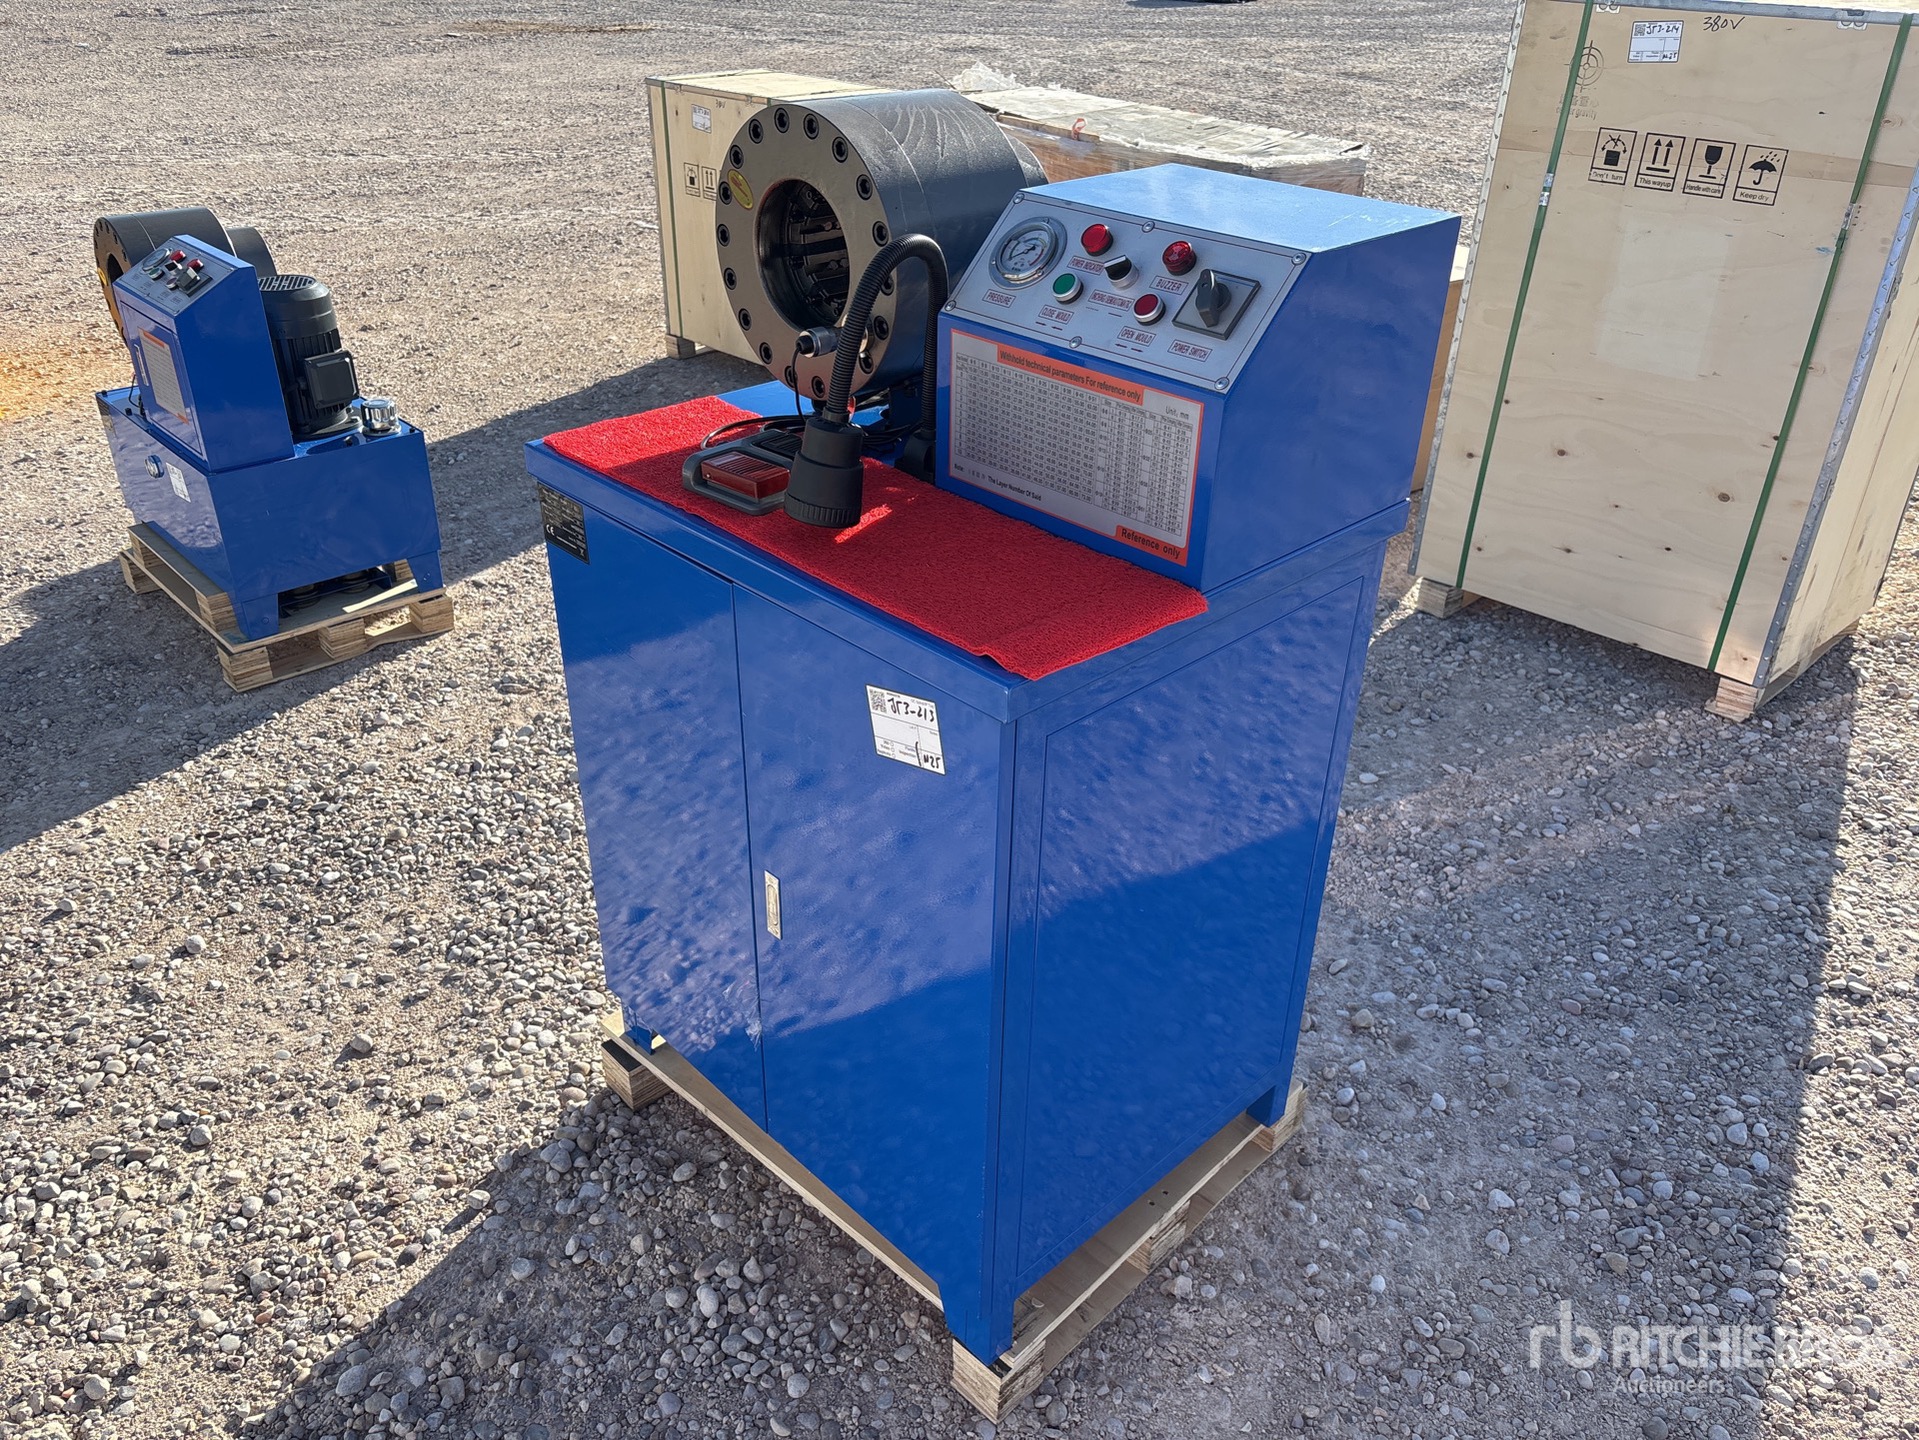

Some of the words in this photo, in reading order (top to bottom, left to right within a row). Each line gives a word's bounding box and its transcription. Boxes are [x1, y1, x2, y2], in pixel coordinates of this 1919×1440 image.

[1703, 16, 1746, 32] 380V
[1740, 191, 1757, 200] Keep
[1758, 194, 1769, 202] dry
[1155, 279, 1182, 292] BUZZER
[987, 292, 1012, 306] PRESSURE
[1042, 307, 1056, 318] CLOSE
[1056, 311, 1071, 322] MOULD
[1121, 328, 1134, 339] OPEN
[1135, 332, 1152, 344] MOULD
[1172, 342, 1190, 354] POWER
[1189, 348, 1209, 360] SWITCH
[1000, 351, 1025, 366] Withhold
[1025, 357, 1051, 373] technical
[1052, 365, 1085, 383] parameters
[1086, 376, 1097, 387] For
[1097, 382, 1126, 396] reference
[1127, 390, 1141, 402] only
[988, 475, 996, 485] The
[996, 479, 1008, 490] Layer
[1009, 483, 1025, 495] Number
[1121, 529, 1159, 550] Reference
[1163, 546, 1180, 559] only
